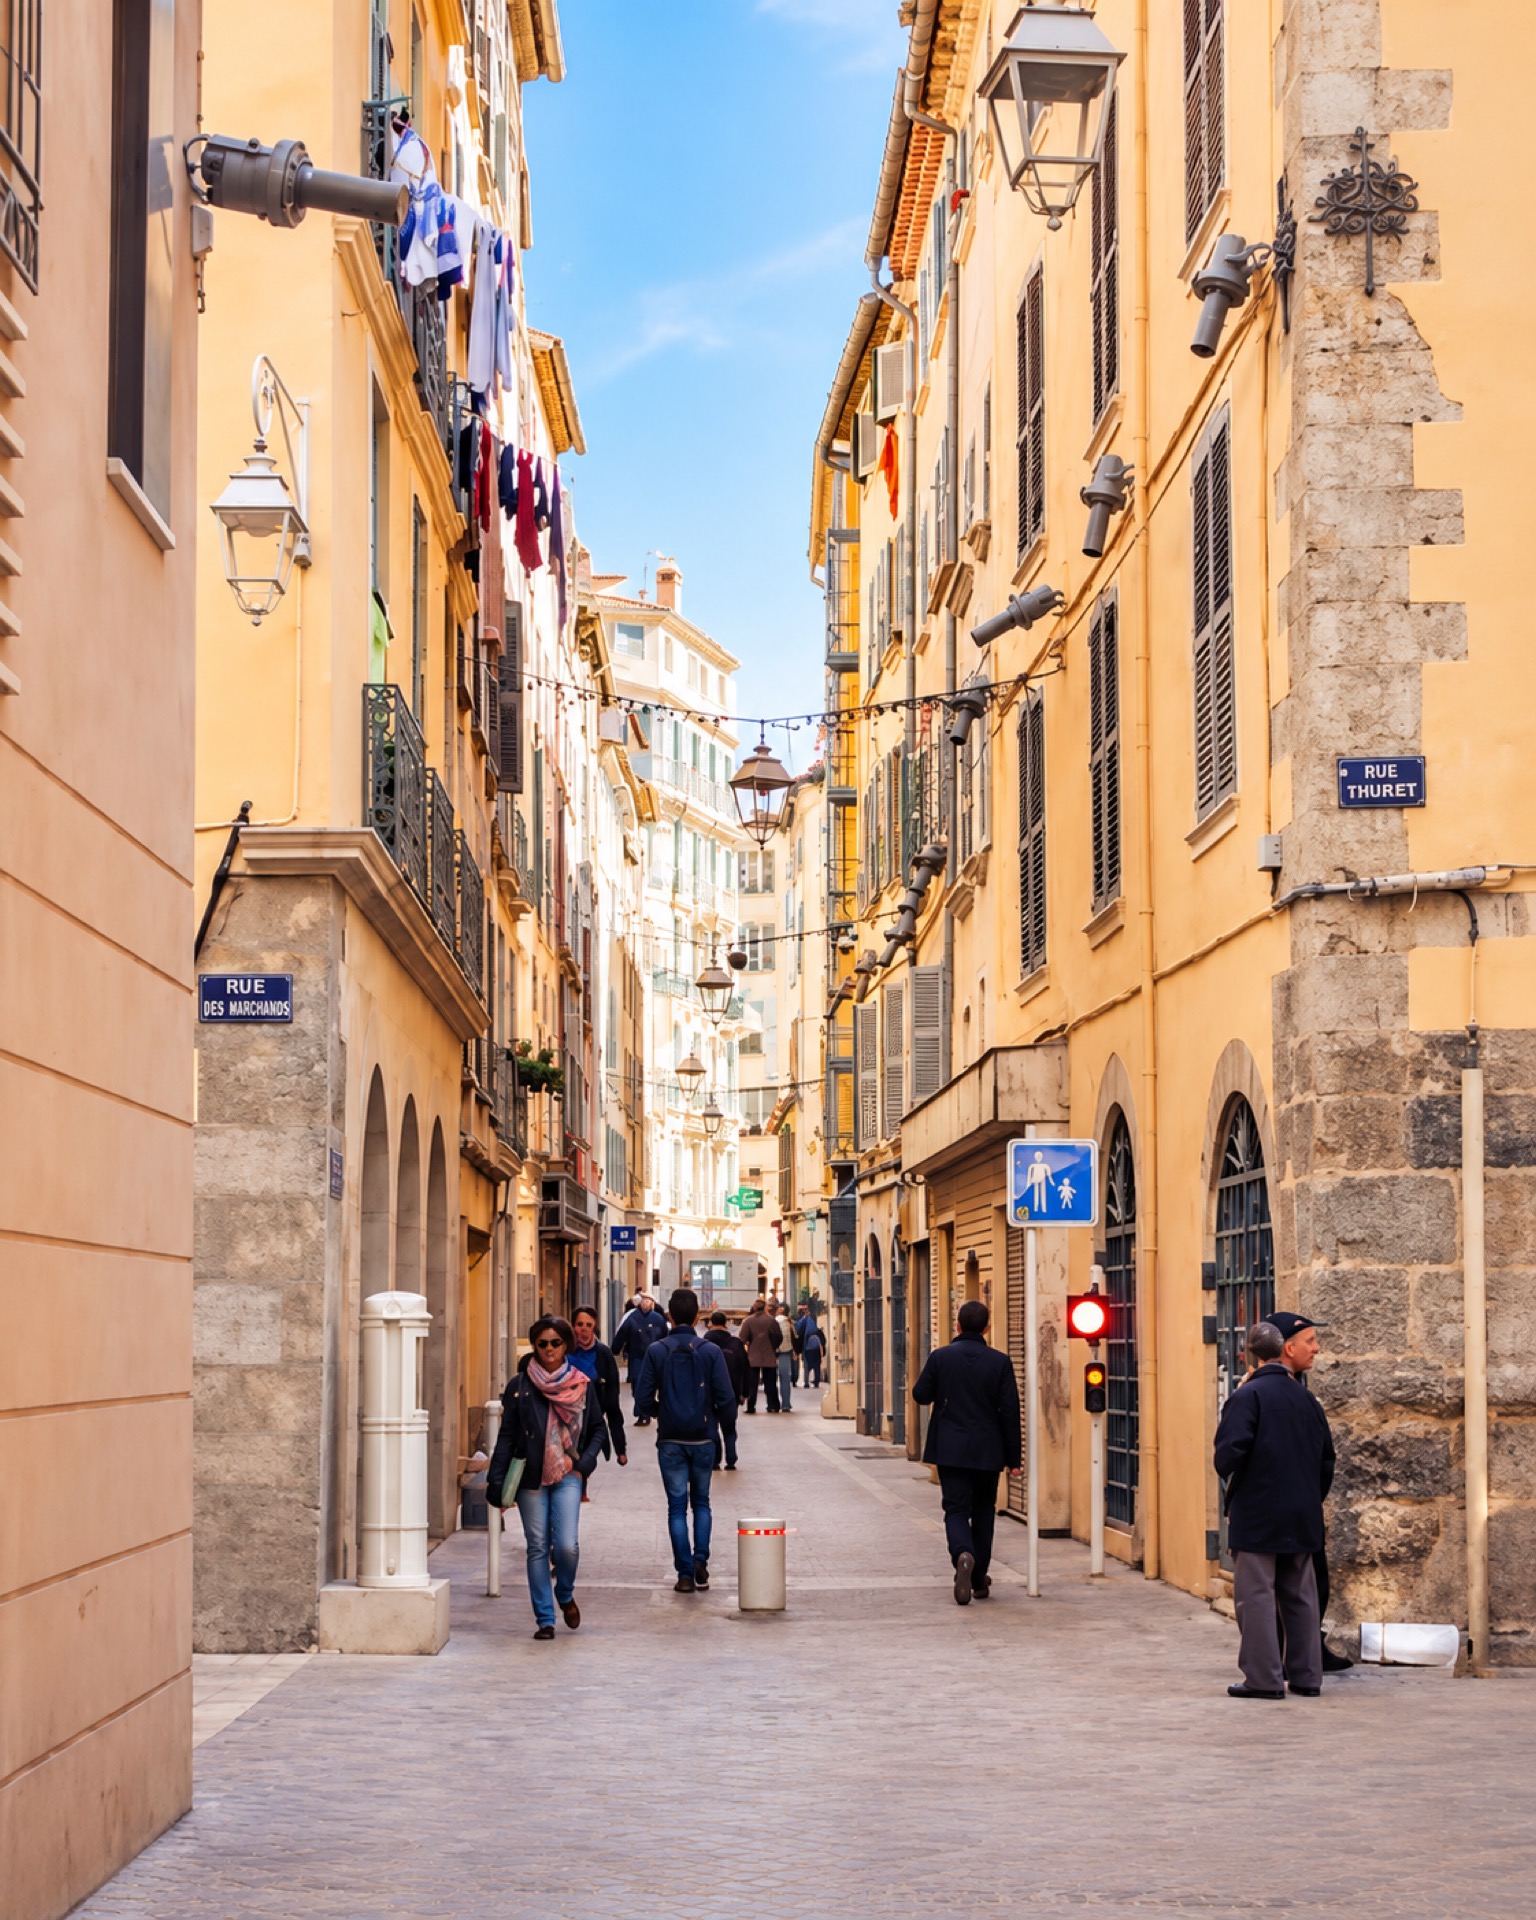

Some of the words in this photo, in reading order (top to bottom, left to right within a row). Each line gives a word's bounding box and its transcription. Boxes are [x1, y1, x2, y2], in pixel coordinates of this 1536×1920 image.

[1364, 763, 1398, 779] RUE
[1347, 783, 1417, 798] THURET
[226, 978, 266, 994] RUE
[203, 1000, 225, 1016] DES
